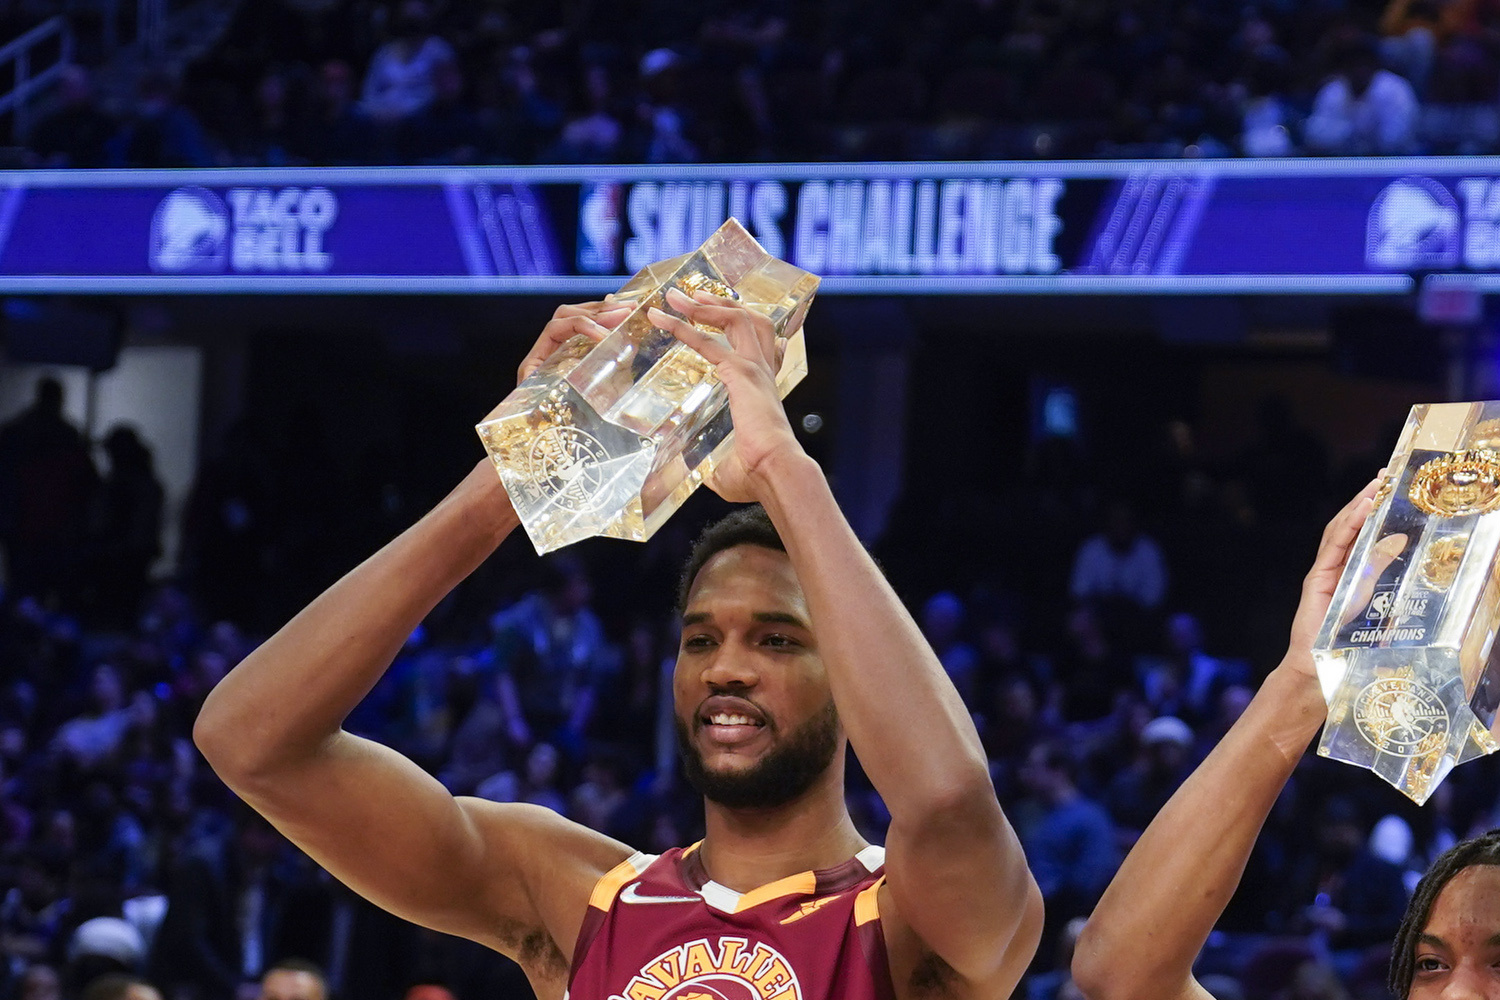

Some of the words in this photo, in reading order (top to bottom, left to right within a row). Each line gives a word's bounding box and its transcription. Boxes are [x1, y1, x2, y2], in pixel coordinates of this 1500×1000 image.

[227, 187, 339, 228] TACO
[795, 178, 1066, 274] CHALLENGE
[231, 227, 335, 272] BELL
[1349, 628, 1427, 643] CHAMPIONS
[1360, 681, 1435, 707] CLEVELAND
